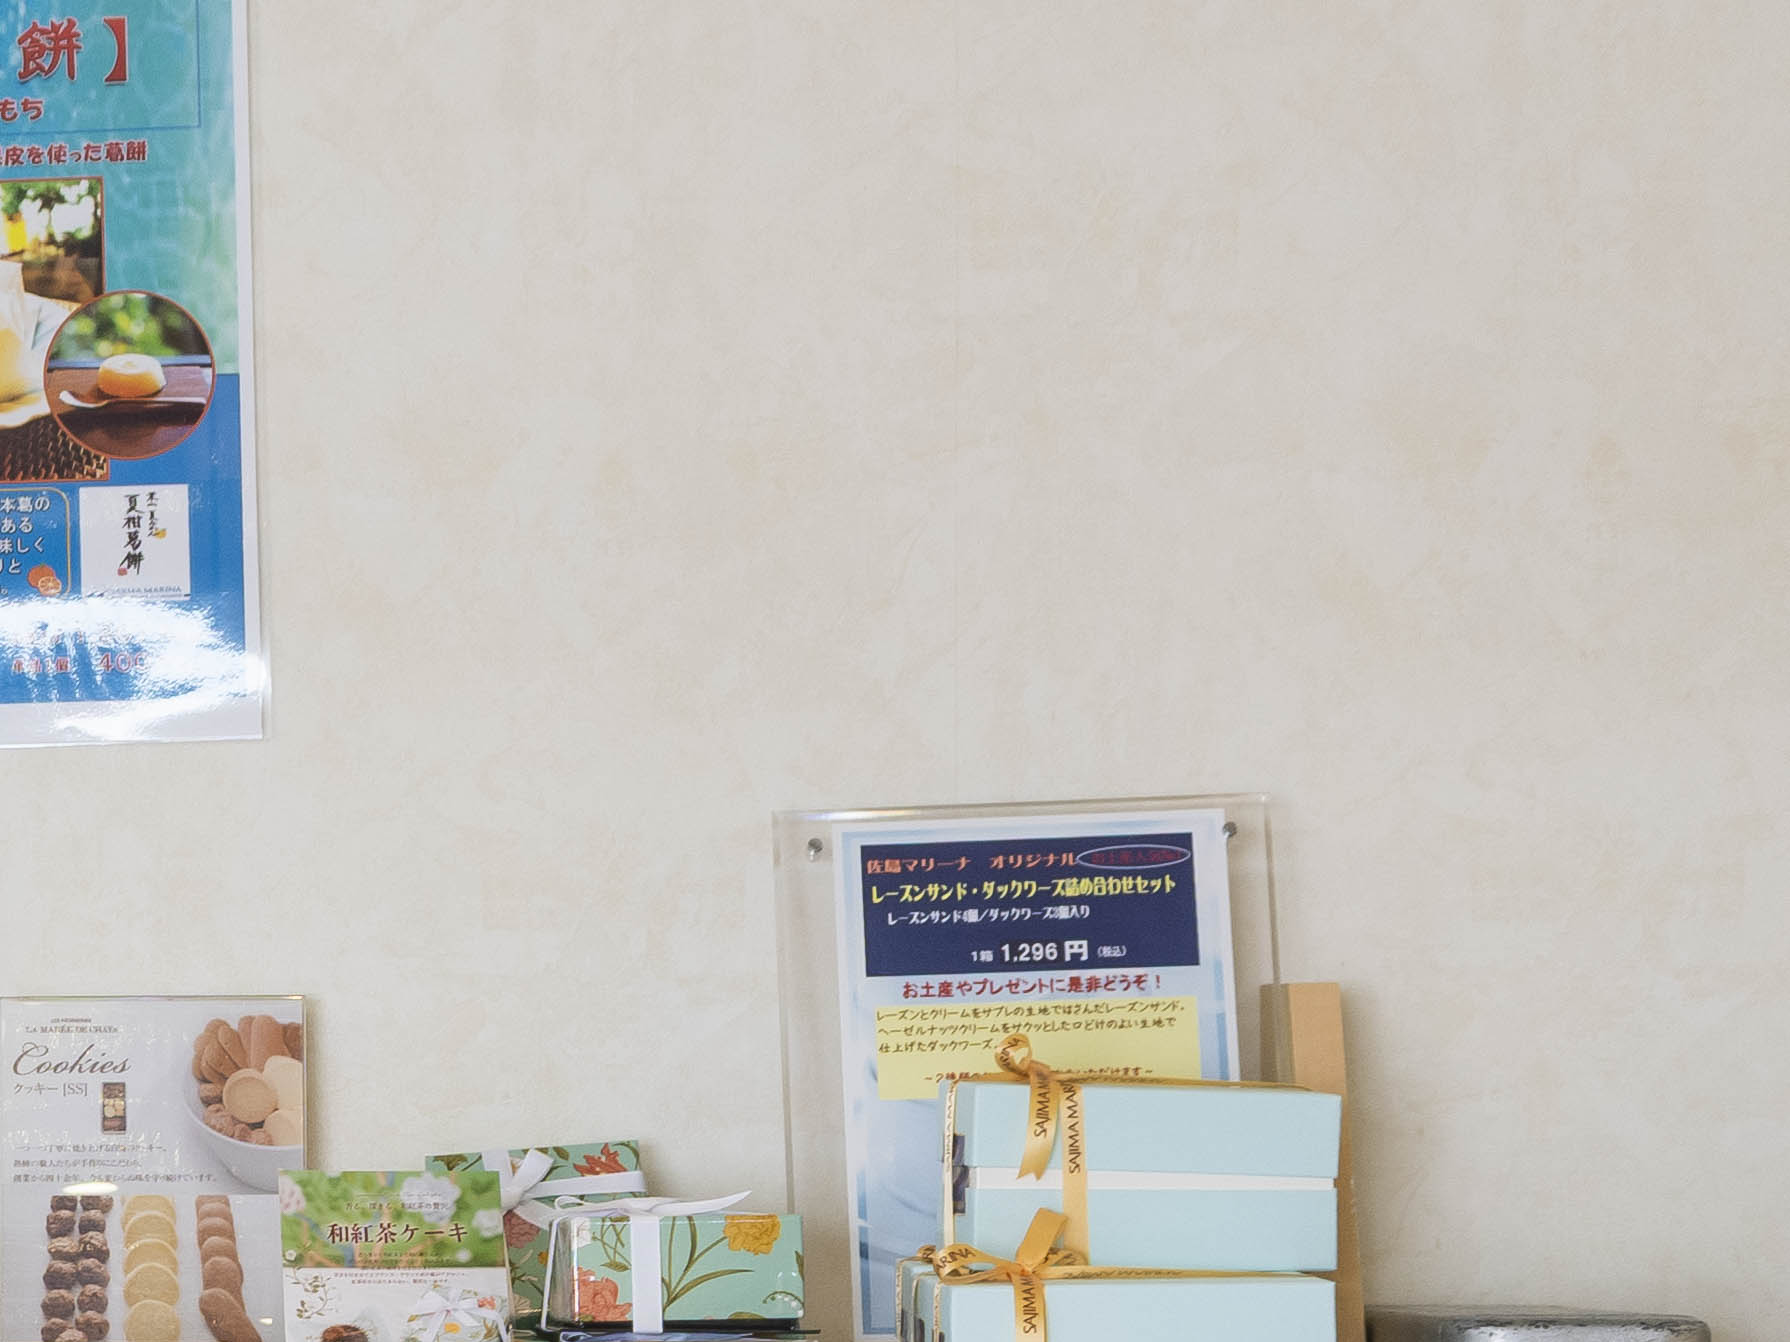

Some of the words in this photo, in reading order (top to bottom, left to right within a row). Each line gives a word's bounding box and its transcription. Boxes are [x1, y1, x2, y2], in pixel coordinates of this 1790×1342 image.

[866, 857, 971, 874] 佐島マリーナ
[990, 853, 1078, 869] オリジナル
[13, 1041, 130, 1077] Cookies
[13, 1082, 58, 1095] クッキー
[1069, 1121, 1082, 1175] SAJIMA
[327, 1222, 469, 1246] 和紅茶ケーキ
